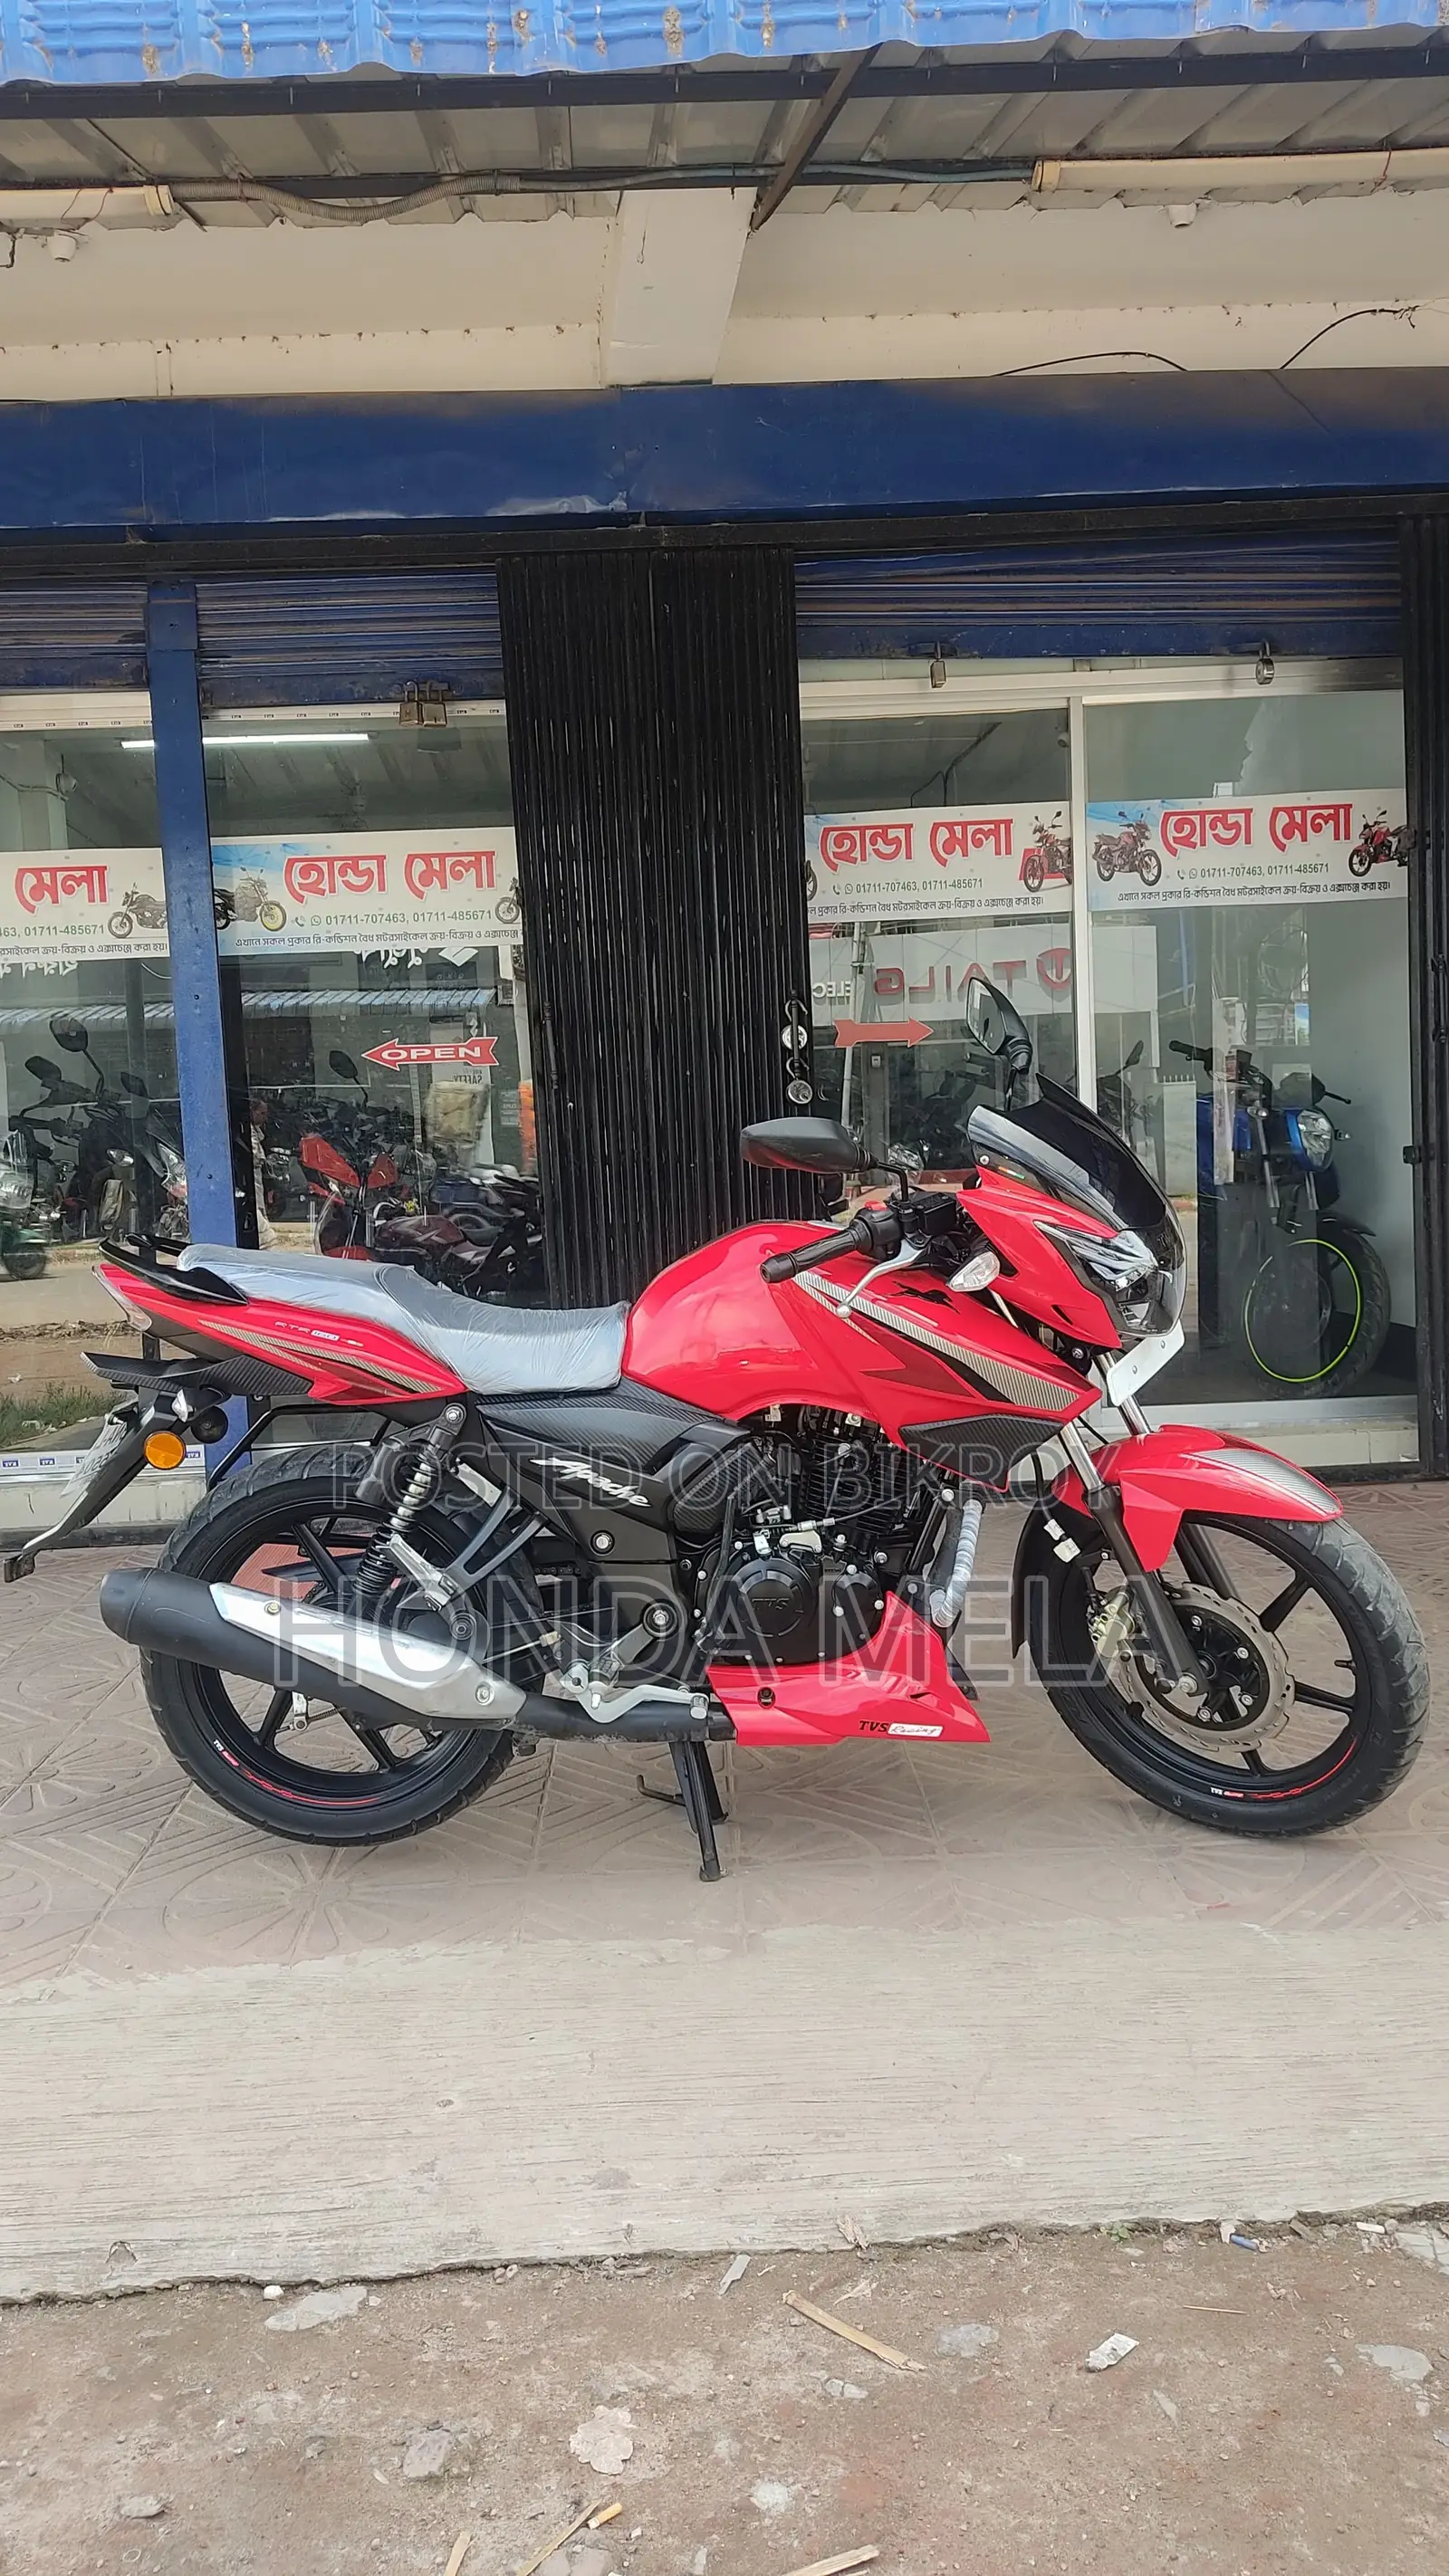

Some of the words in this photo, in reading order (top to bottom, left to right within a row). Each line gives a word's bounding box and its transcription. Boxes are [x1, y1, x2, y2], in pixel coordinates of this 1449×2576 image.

[1160, 808, 1254, 857] হোন্ডা
[1269, 803, 1353, 853] মেলা
[820, 822, 914, 873] হোন্ডা
[929, 818, 1013, 868] মেলা
[283, 854, 387, 904] হোন্ডা
[404, 850, 496, 900] মেলা
[1200, 866, 1265, 878] 01711-707463,
[1267, 863, 1329, 876] 01711-485671
[14, 865, 108, 914] মেলা
[855, 881, 920, 894] 01711-707463,
[922, 877, 983, 890] 01711-485671
[325, 913, 409, 925] 01711-707463,
[413, 910, 492, 923] 01711-485671
[24, 924, 105, 937] 01711-485671
[380, 1046, 481, 1060] OPEN
[529, 1457, 652, 1508] Apache
[859, 1719, 888, 1733] TVS
